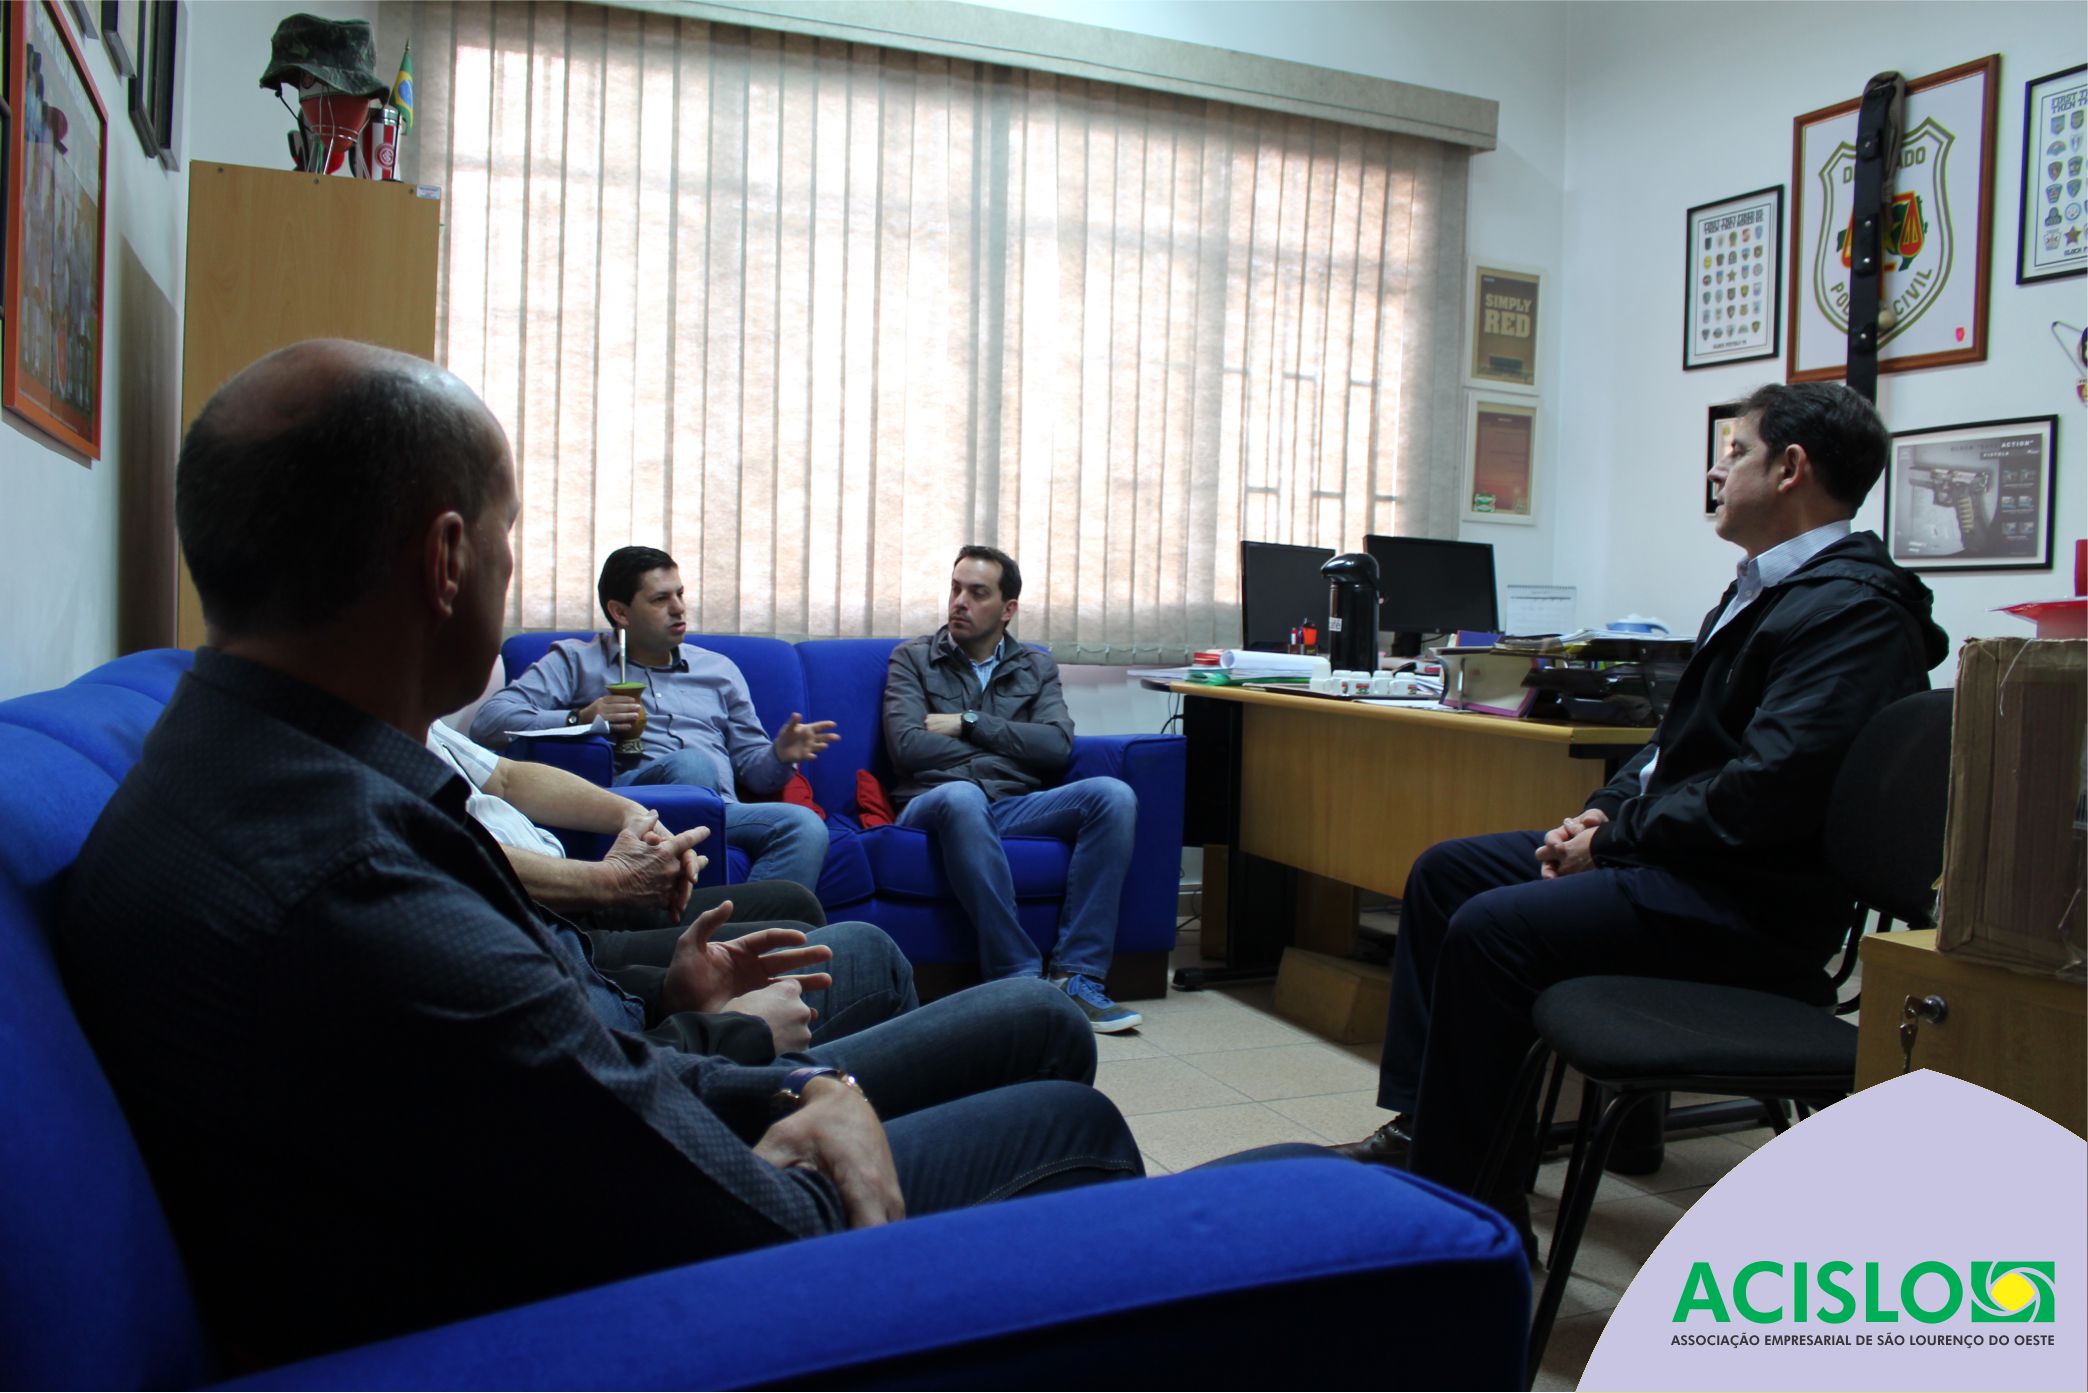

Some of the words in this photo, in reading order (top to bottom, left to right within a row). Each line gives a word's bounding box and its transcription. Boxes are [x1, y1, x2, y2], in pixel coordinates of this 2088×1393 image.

[2051, 92, 2077, 106] FIRST
[1486, 293, 1532, 313] SIMPLY
[1893, 268, 1933, 316] CIVIL
[1484, 309, 1531, 338] RED
